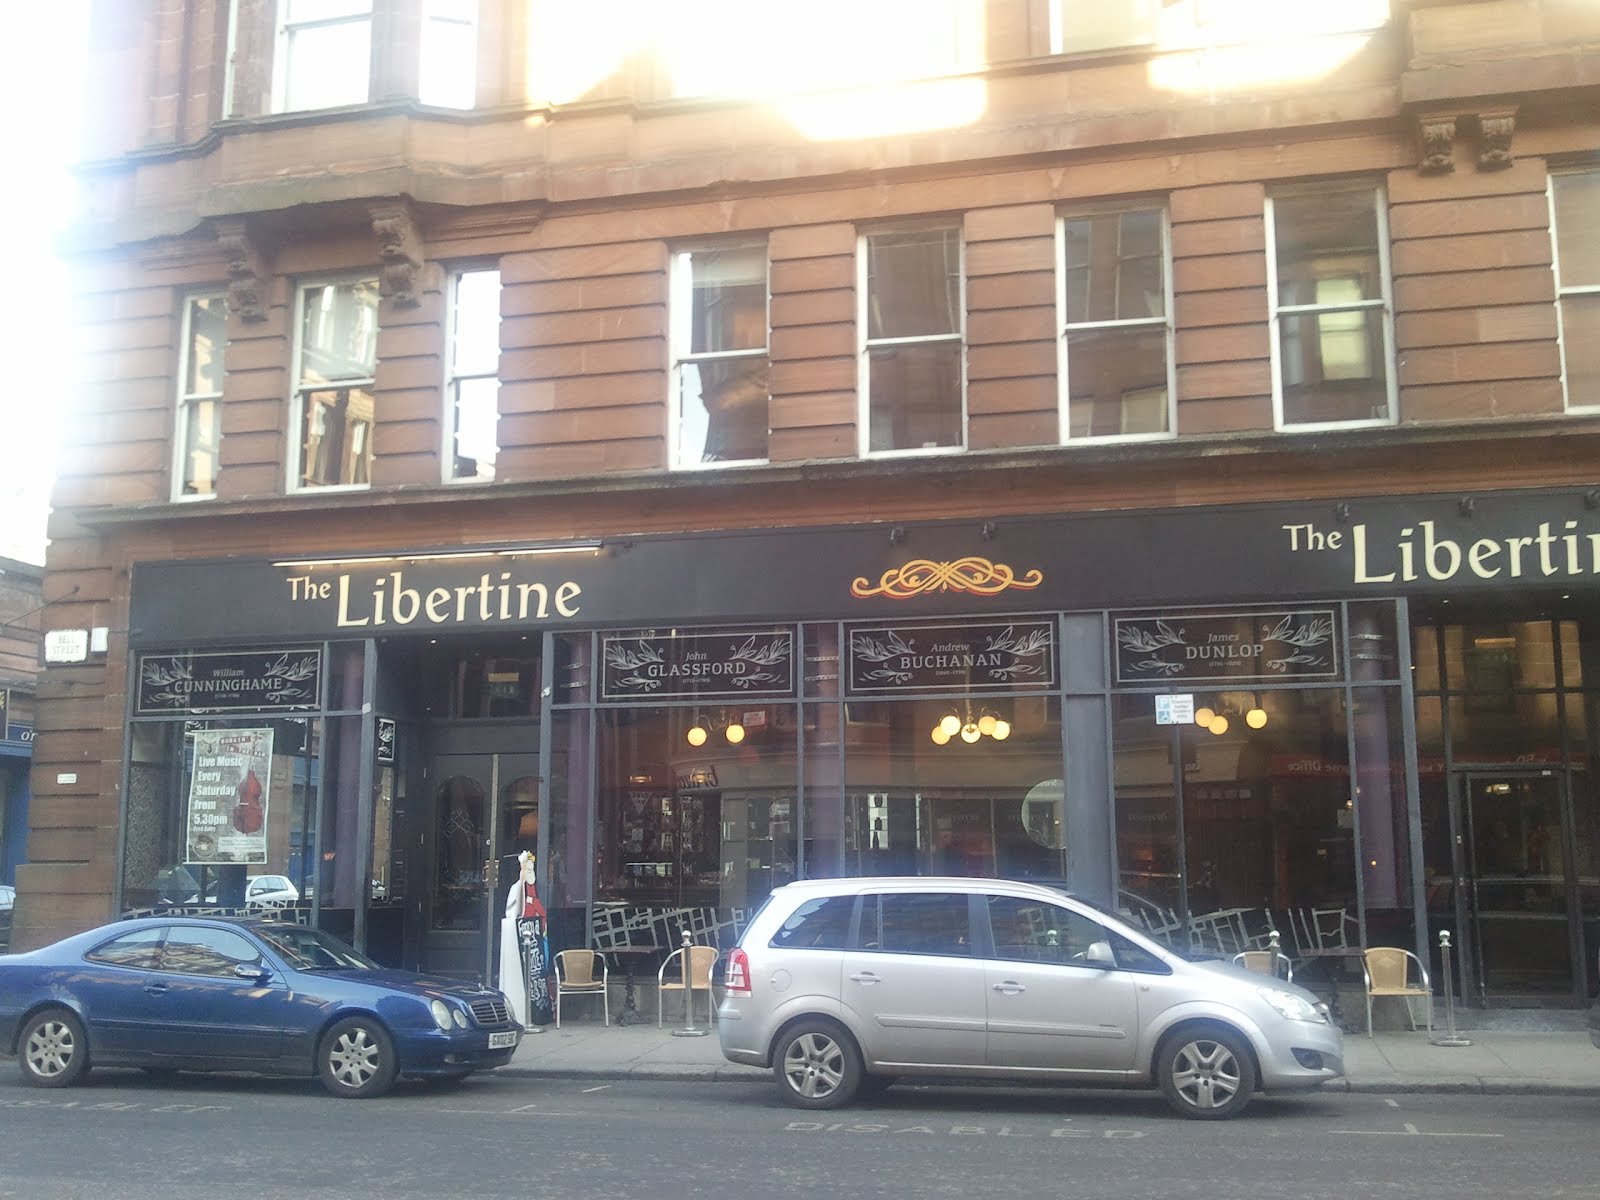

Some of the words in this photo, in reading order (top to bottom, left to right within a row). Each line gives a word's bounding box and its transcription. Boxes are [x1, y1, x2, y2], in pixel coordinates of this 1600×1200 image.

[1282, 523, 1342, 551] The
[286, 576, 331, 600] The
[337, 571, 582, 627] Libertine
[1207, 633, 1240, 642] James
[52, 645, 80, 655] STREET
[931, 643, 970, 653] Andrew
[1185, 644, 1264, 660] DUNLOP
[685, 652, 707, 661] John
[900, 653, 1001, 669] BUCHANAN
[213, 668, 244, 677] William
[648, 662, 746, 677] GLASSFORD
[174, 678, 282, 693] CUNNINGHAME
[198, 756, 216, 767] Live
[217, 757, 244, 767] Music
[197, 771, 221, 782] Every
[196, 785, 236, 796] Saturday
[194, 800, 216, 810] from
[193, 814, 228, 825] 5.30pm
[784, 1121, 1150, 1140] DISABLED
